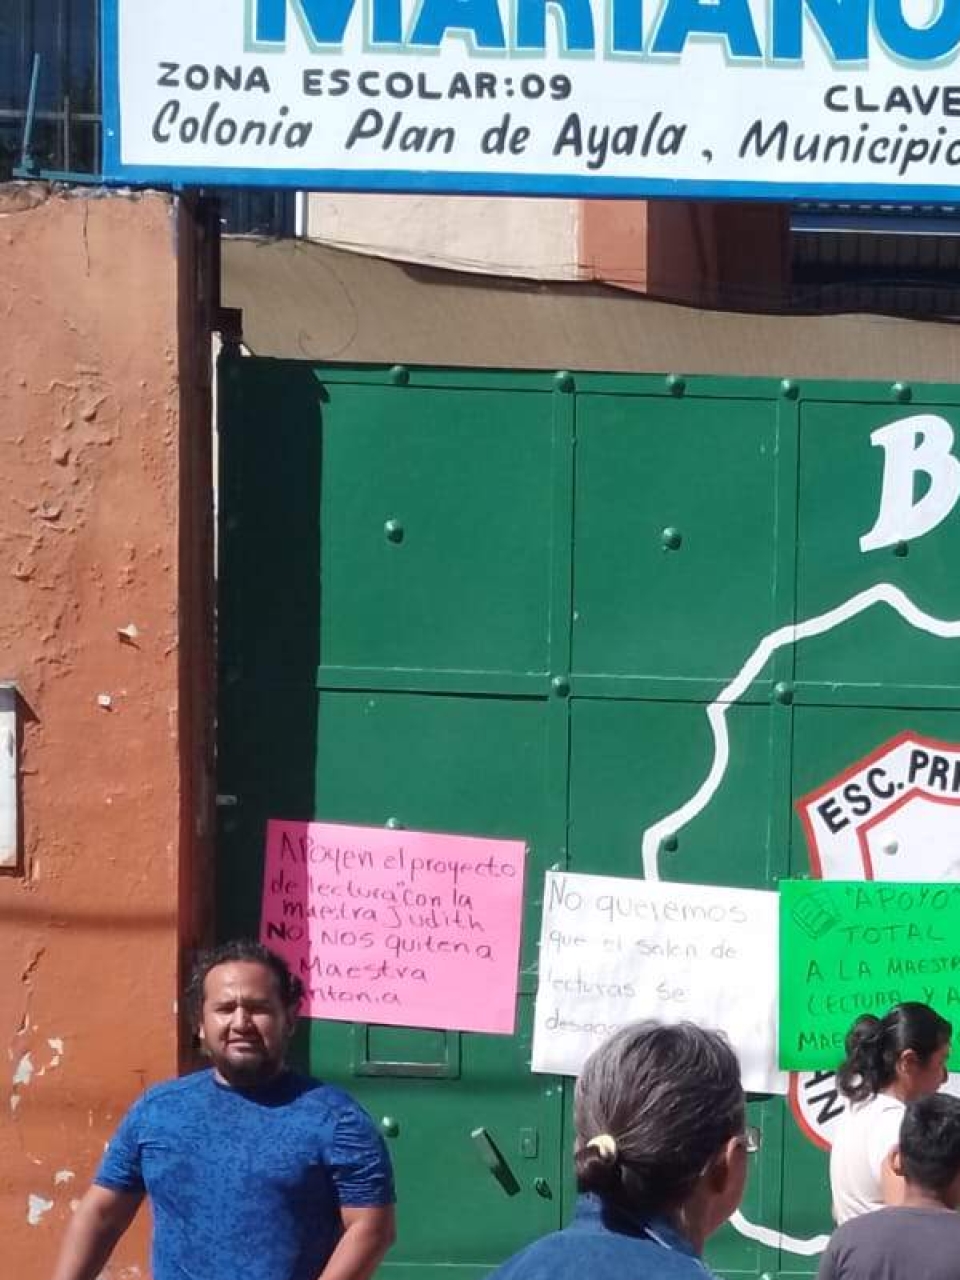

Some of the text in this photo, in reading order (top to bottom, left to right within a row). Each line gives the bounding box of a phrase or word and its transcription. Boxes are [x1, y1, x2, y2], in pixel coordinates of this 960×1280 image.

[156, 61, 573, 100] ZONA ESCOLAR:09
[152, 100, 313, 148] Colonia
[346, 108, 455, 154] Plan
[481, 112, 528, 155] de
[817, 767, 905, 834] ESC.
[383, 848, 404, 871] el
[410, 856, 517, 882] proyecto
[271, 868, 298, 895] de
[453, 888, 474, 911] la
[548, 878, 748, 924] No queremos
[383, 904, 485, 931] Judith
[550, 929, 586, 954] que
[711, 940, 739, 960] de
[842, 923, 946, 945] TOTAL
[300, 954, 427, 983] Maestra
[806, 958, 824, 984] A
[839, 958, 871, 981] LA
[302, 984, 401, 1005] ntonia
[922, 986, 935, 1005] Y
[946, 986, 960, 1006] A
